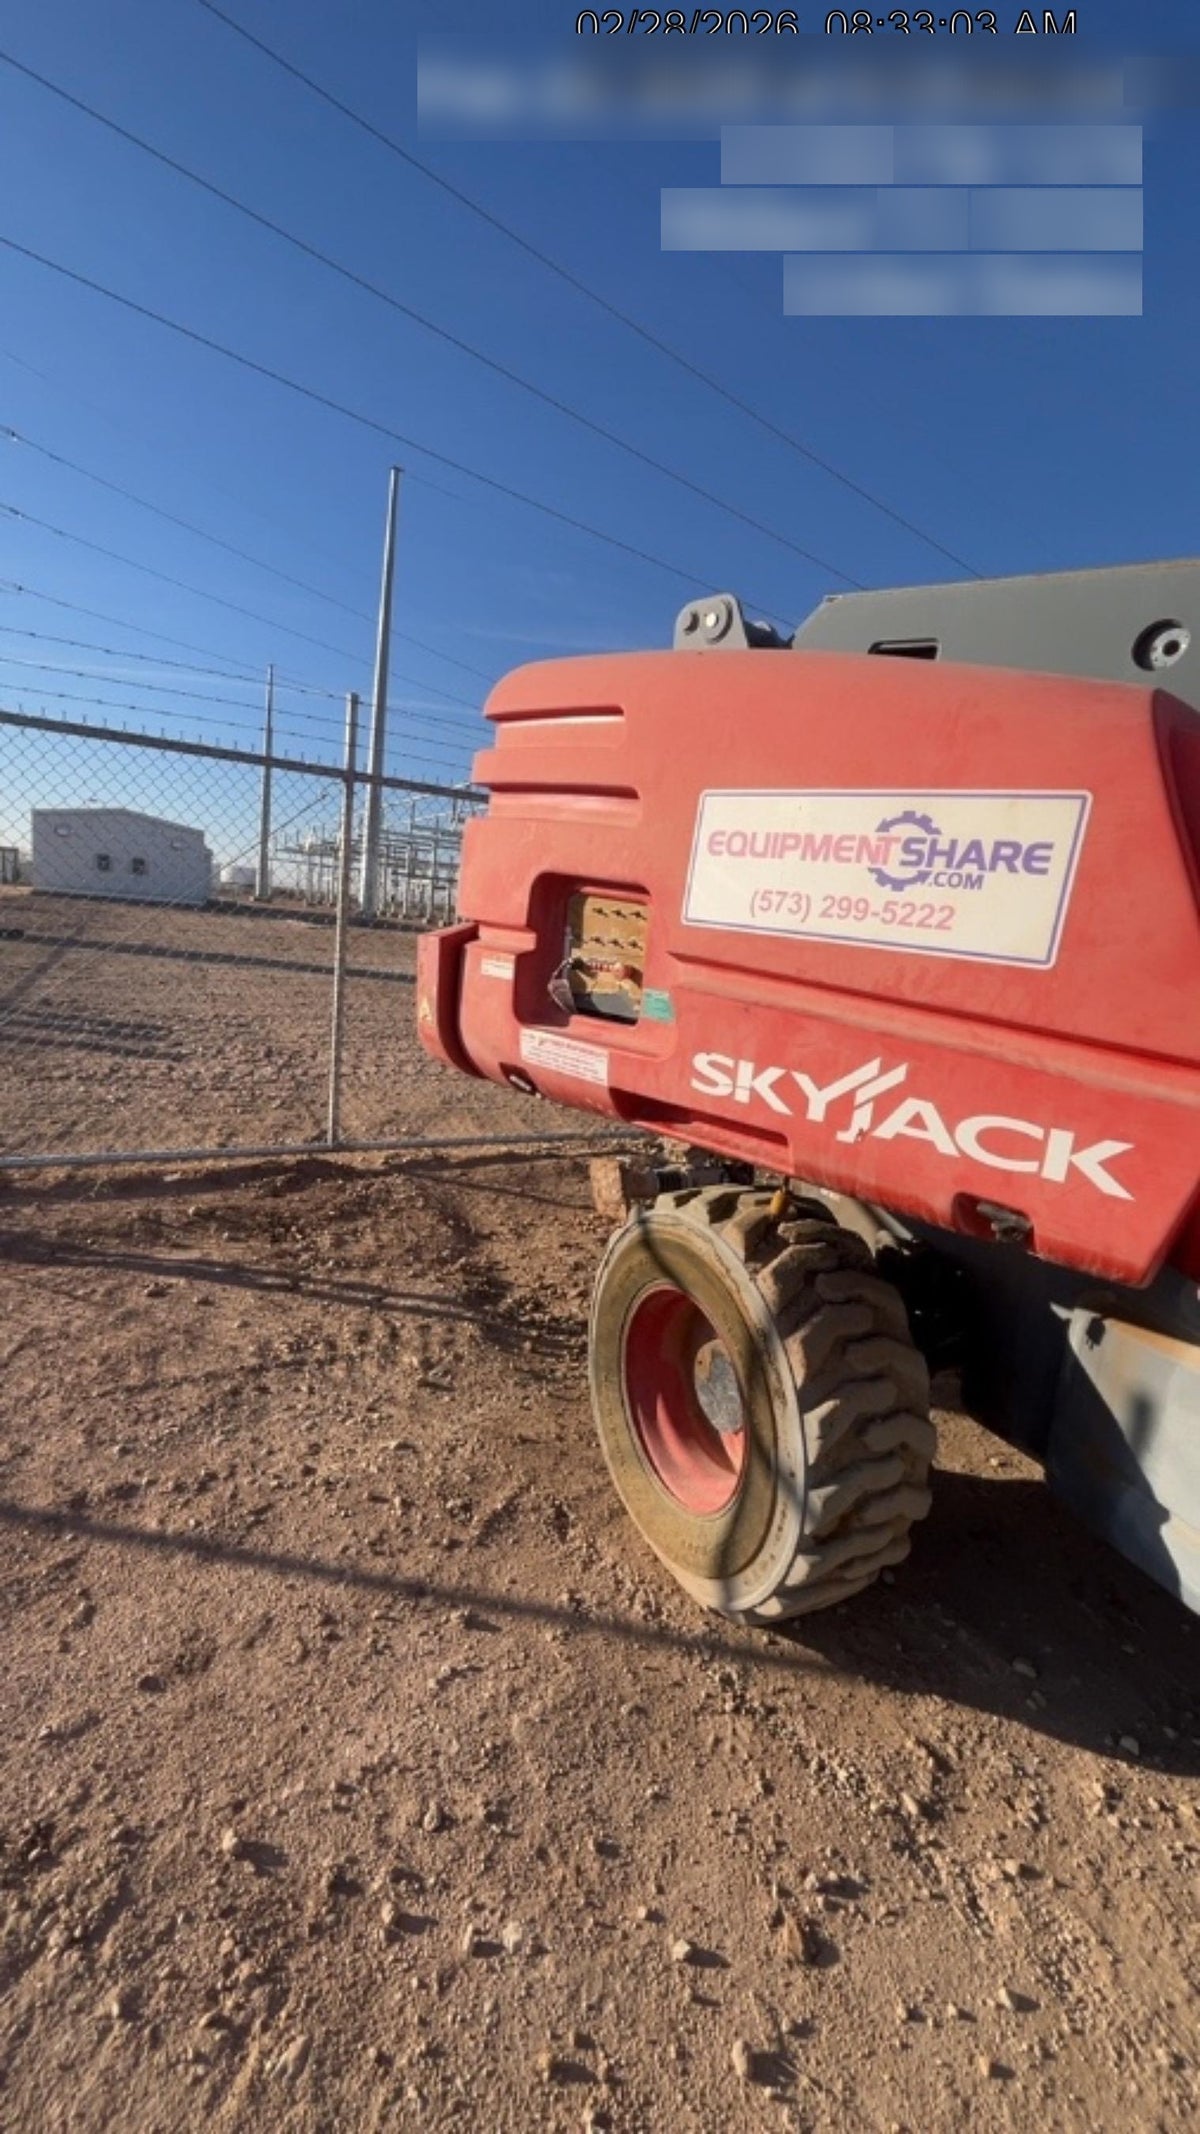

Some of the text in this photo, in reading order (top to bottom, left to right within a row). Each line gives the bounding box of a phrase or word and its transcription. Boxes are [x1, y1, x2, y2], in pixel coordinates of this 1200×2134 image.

[708, 831, 1053, 875] EQUIPMENTSHARE
[928, 872, 984, 890] .COM
[750, 889, 956, 931] (573) 299-5222
[690, 1052, 1135, 1201] SKYJACK
